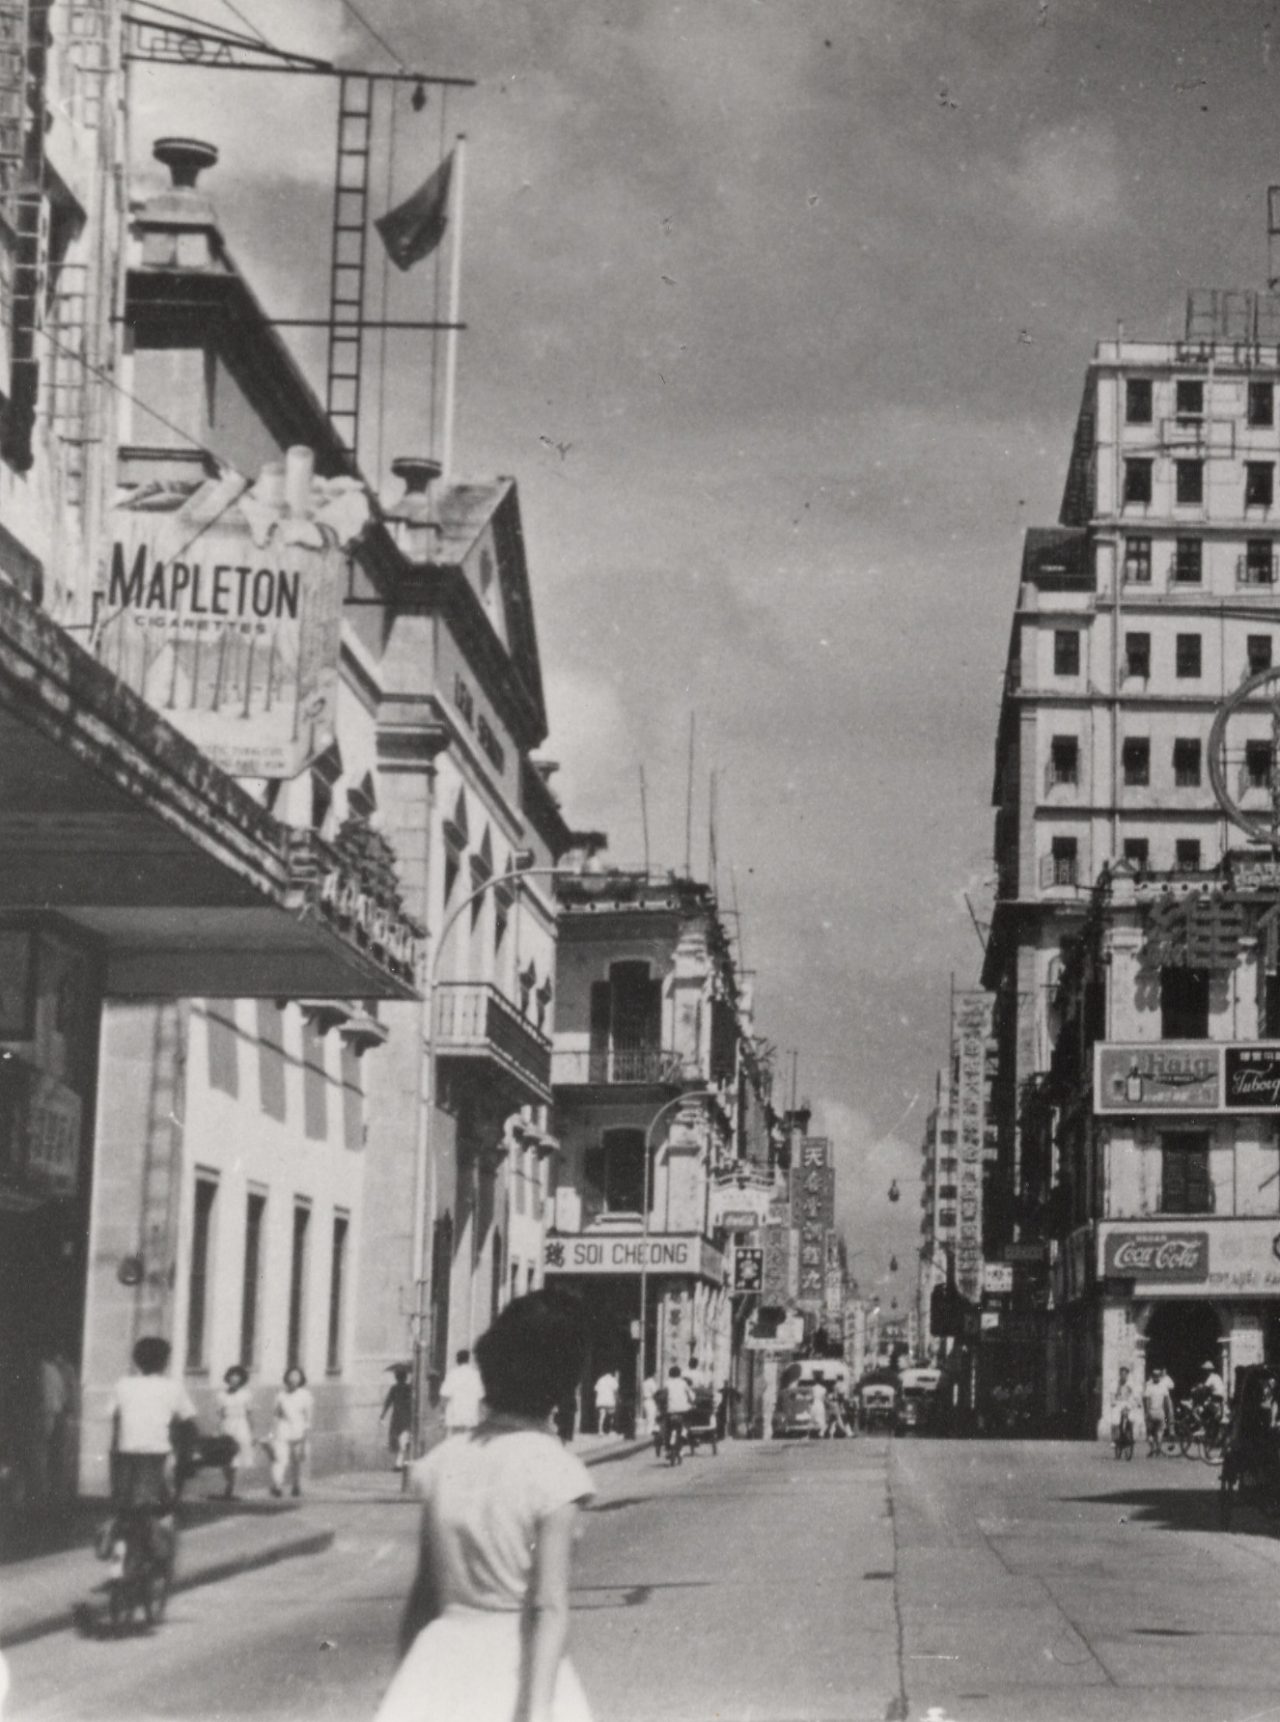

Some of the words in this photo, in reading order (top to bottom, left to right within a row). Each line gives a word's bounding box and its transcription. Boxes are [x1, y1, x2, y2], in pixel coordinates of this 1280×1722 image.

[108, 541, 300, 620] MAPLETON
[134, 615, 268, 635] CIGARETTES
[1147, 1052, 1210, 1080] Haig
[573, 1243, 604, 1266] SOI
[611, 1243, 688, 1266] CHEONG
